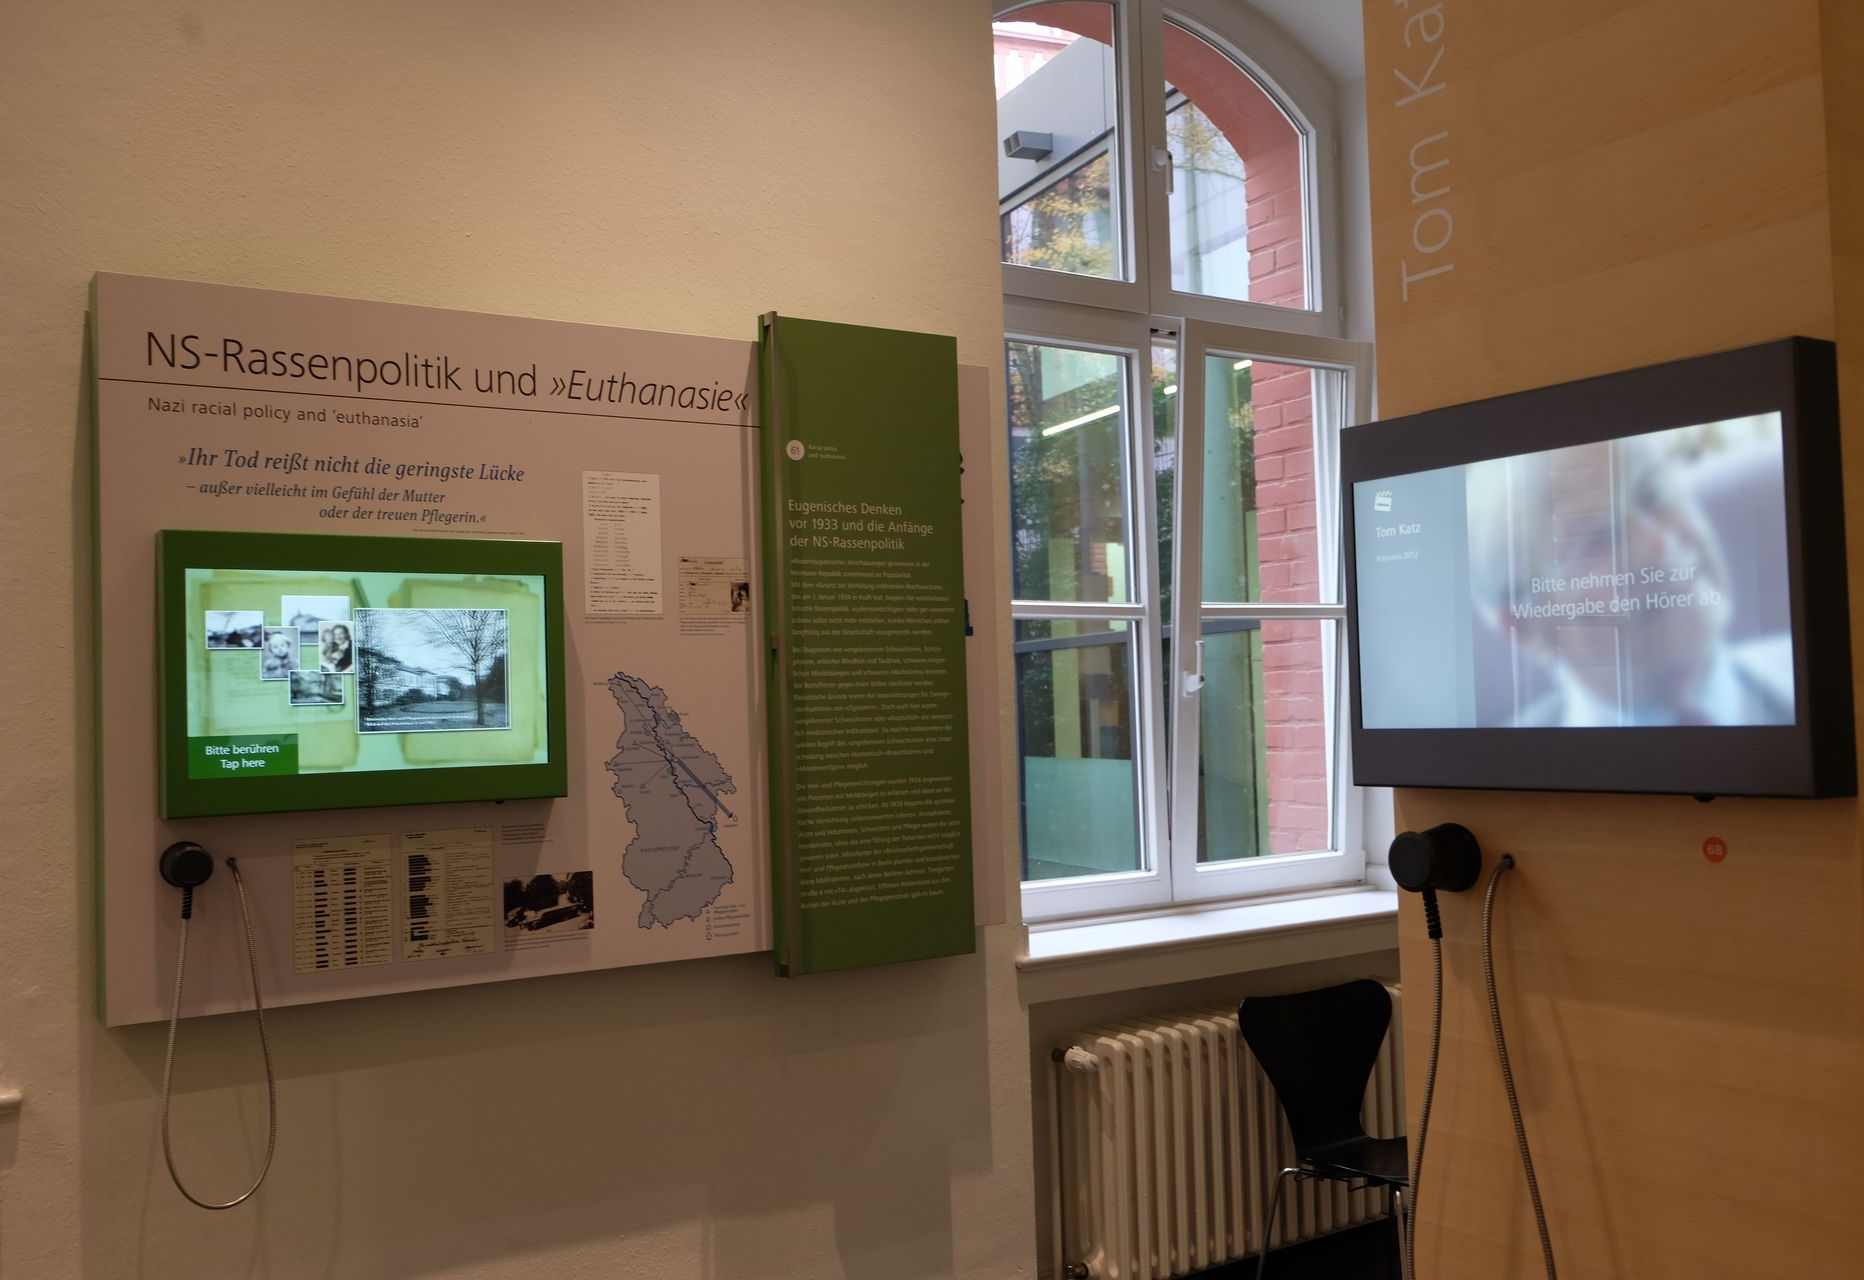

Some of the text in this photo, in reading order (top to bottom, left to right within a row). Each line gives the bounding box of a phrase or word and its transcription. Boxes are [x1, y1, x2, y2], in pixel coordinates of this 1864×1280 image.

[1393, 0, 1454, 302] Tom Ka
[147, 331, 750, 412] NS-Rassenpolitik und »Euthanasie«
[148, 397, 186, 413] Nazi
[192, 400, 237, 417] racial
[243, 404, 292, 423] policy
[297, 408, 327, 423] and
[178, 447, 525, 483] »Ihr Tod reißt nicht die geringste Lücke
[199, 480, 243, 497] außer
[245, 482, 307, 498] vielleicht
[311, 486, 328, 498] im
[332, 485, 375, 502] Gefühl
[378, 488, 400, 501] der
[402, 489, 446, 503] Mutter
[319, 505, 487, 525] oder der treuen Pflegerin.«
[788, 498, 903, 516] Eugenisches Denken
[789, 518, 934, 537] vor 1933 und die Anfänge
[1375, 523, 1422, 538] Tom Katz
[789, 534, 906, 552] der NS-Rassenpolitik
[1531, 566, 1697, 594] Bitte nehmen Sie zur
[1511, 587, 1722, 620] Wiedergabe den Hörer ab
[205, 743, 280, 756] Bitte berühren
[219, 758, 266, 771] Tap here
[1706, 843, 1723, 856] 68
